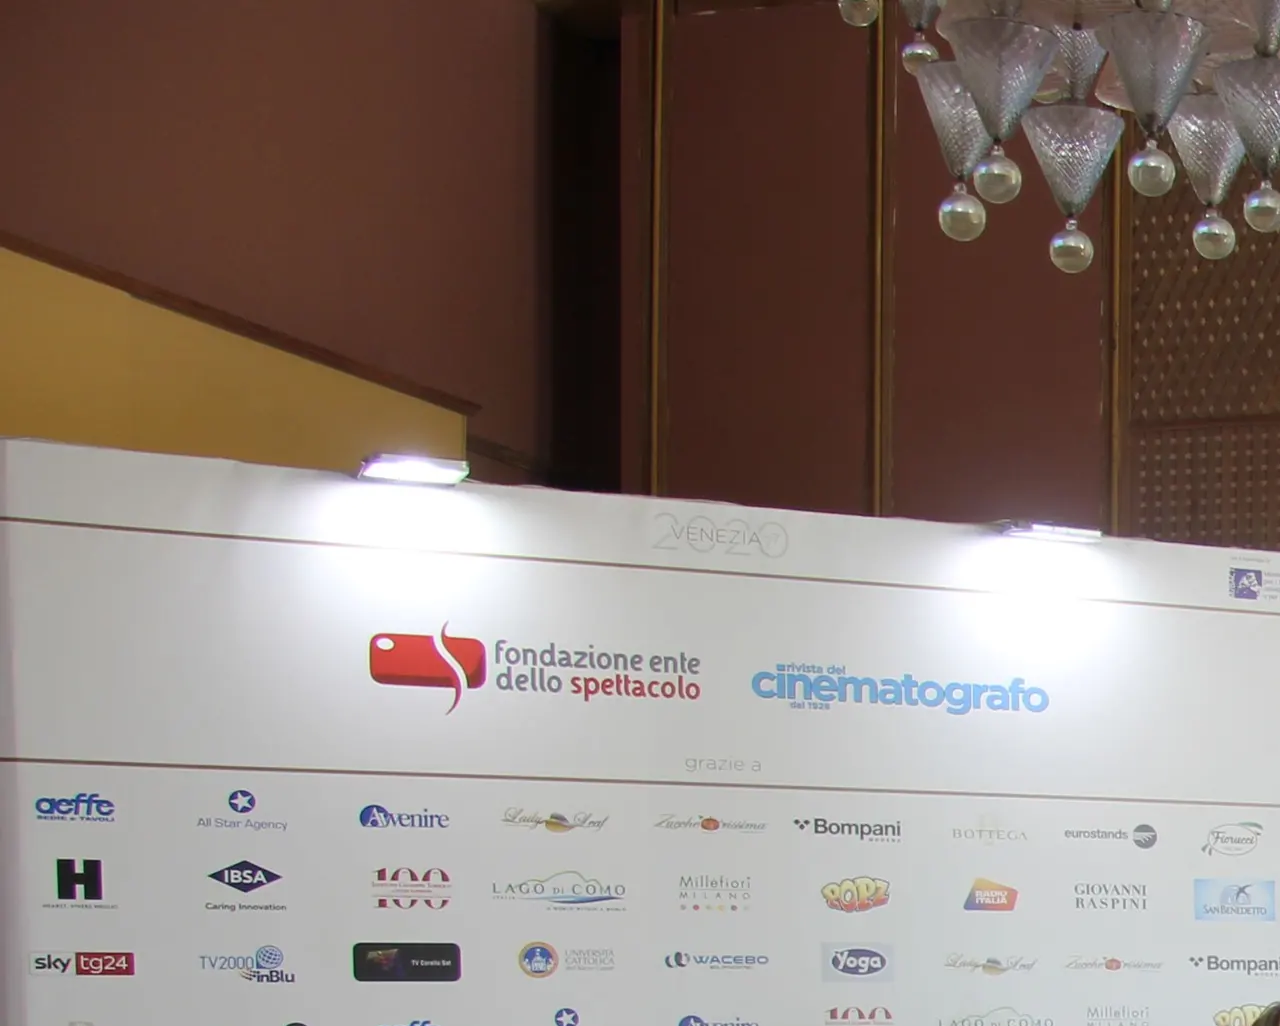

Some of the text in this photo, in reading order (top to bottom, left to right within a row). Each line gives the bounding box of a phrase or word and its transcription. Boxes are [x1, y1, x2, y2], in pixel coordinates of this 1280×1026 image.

[671, 524, 763, 547] VENEZIA
[495, 640, 701, 675] fondazione ente
[787, 663, 846, 675] rivista del
[496, 666, 701, 702] dello spettacolo
[751, 668, 1050, 715] cinematografo
[685, 756, 762, 773] grazie a
[35, 793, 115, 817] aeffe
[360, 804, 449, 828] Avvenire
[197, 817, 288, 832] All Star Agency
[814, 818, 900, 839] Bompani
[953, 828, 1028, 840] BOTTEGA
[1064, 829, 1128, 840] eurostands
[1211, 831, 1256, 846] Fiorucci
[57, 859, 102, 900] H
[224, 870, 267, 884] IBSA
[680, 875, 750, 889] Millefiori
[492, 881, 626, 896] LAGO COMO
[975, 890, 1008, 898] RADIO
[1075, 883, 1147, 897] GIOVANNI
[680, 892, 750, 900] MILANO
[975, 897, 1008, 905] ITALIA
[205, 903, 287, 912] Caring Innovation
[1075, 897, 1147, 910] RASPINI
[34, 954, 128, 974] sky tg24
[199, 956, 254, 970] TV2000
[694, 955, 769, 966] WACEBO
[835, 950, 882, 974] Yoga
[255, 970, 295, 983] inBlu
[1087, 1006, 1149, 1019] Millefiori
